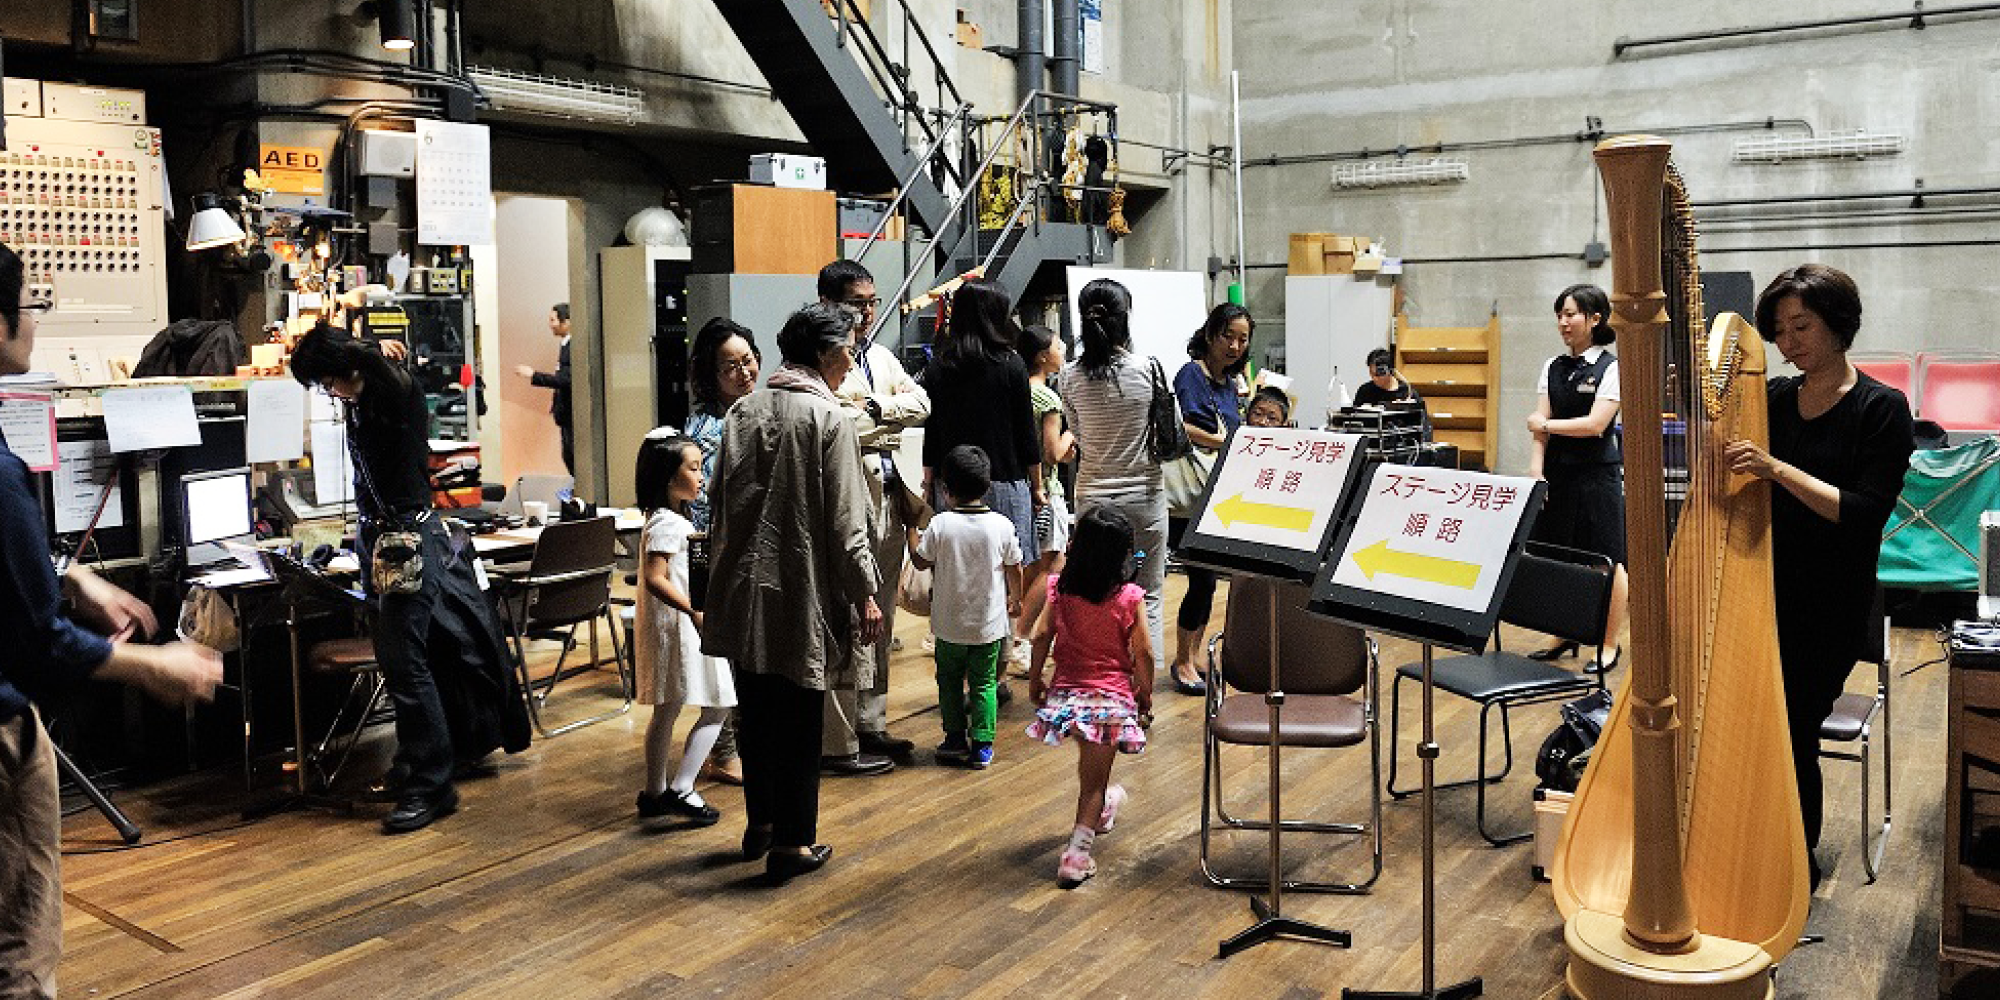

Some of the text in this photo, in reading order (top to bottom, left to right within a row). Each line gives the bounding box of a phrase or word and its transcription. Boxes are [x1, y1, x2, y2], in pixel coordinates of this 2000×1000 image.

[424, 131, 433, 145] 6
[264, 150, 318, 168] AED
[1237, 434, 1347, 464] ステージ見学
[1379, 473, 1519, 512] ステージ見学
